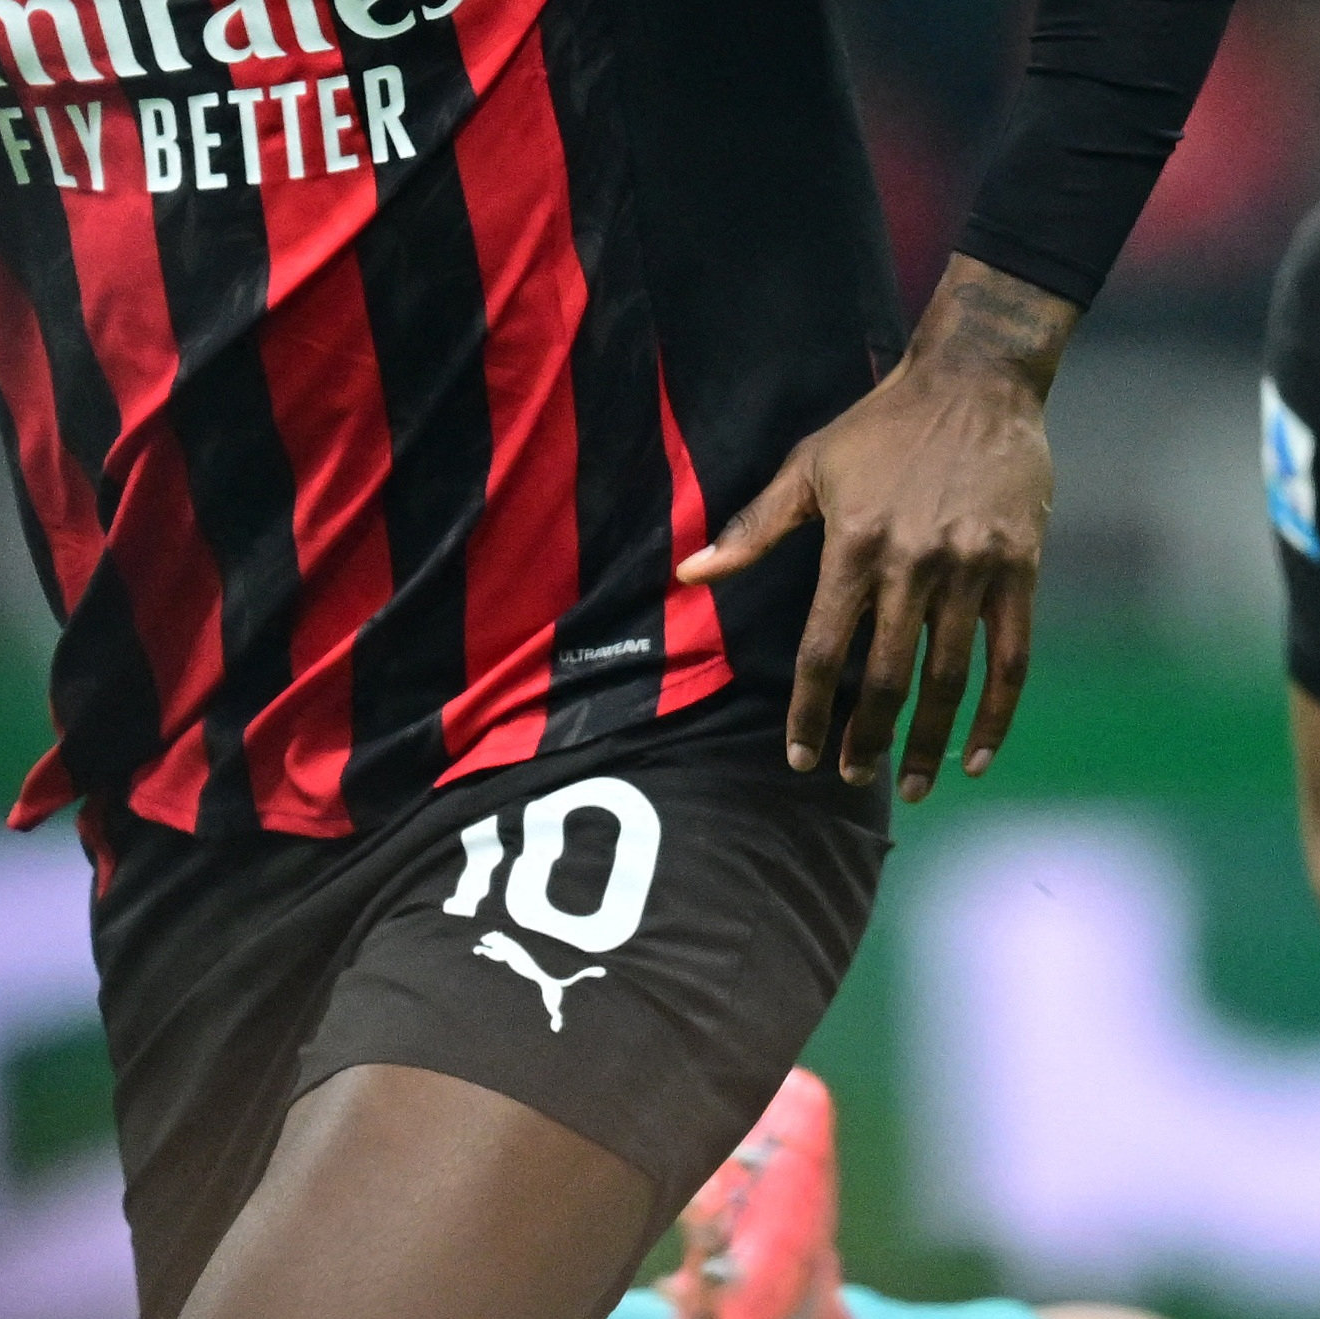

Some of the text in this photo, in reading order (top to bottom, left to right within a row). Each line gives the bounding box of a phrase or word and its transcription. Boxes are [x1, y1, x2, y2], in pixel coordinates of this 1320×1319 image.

[138, 64, 417, 194] BETTER
[558, 638, 652, 663] ULTRAWEAVE
[442, 776, 662, 954] 10
